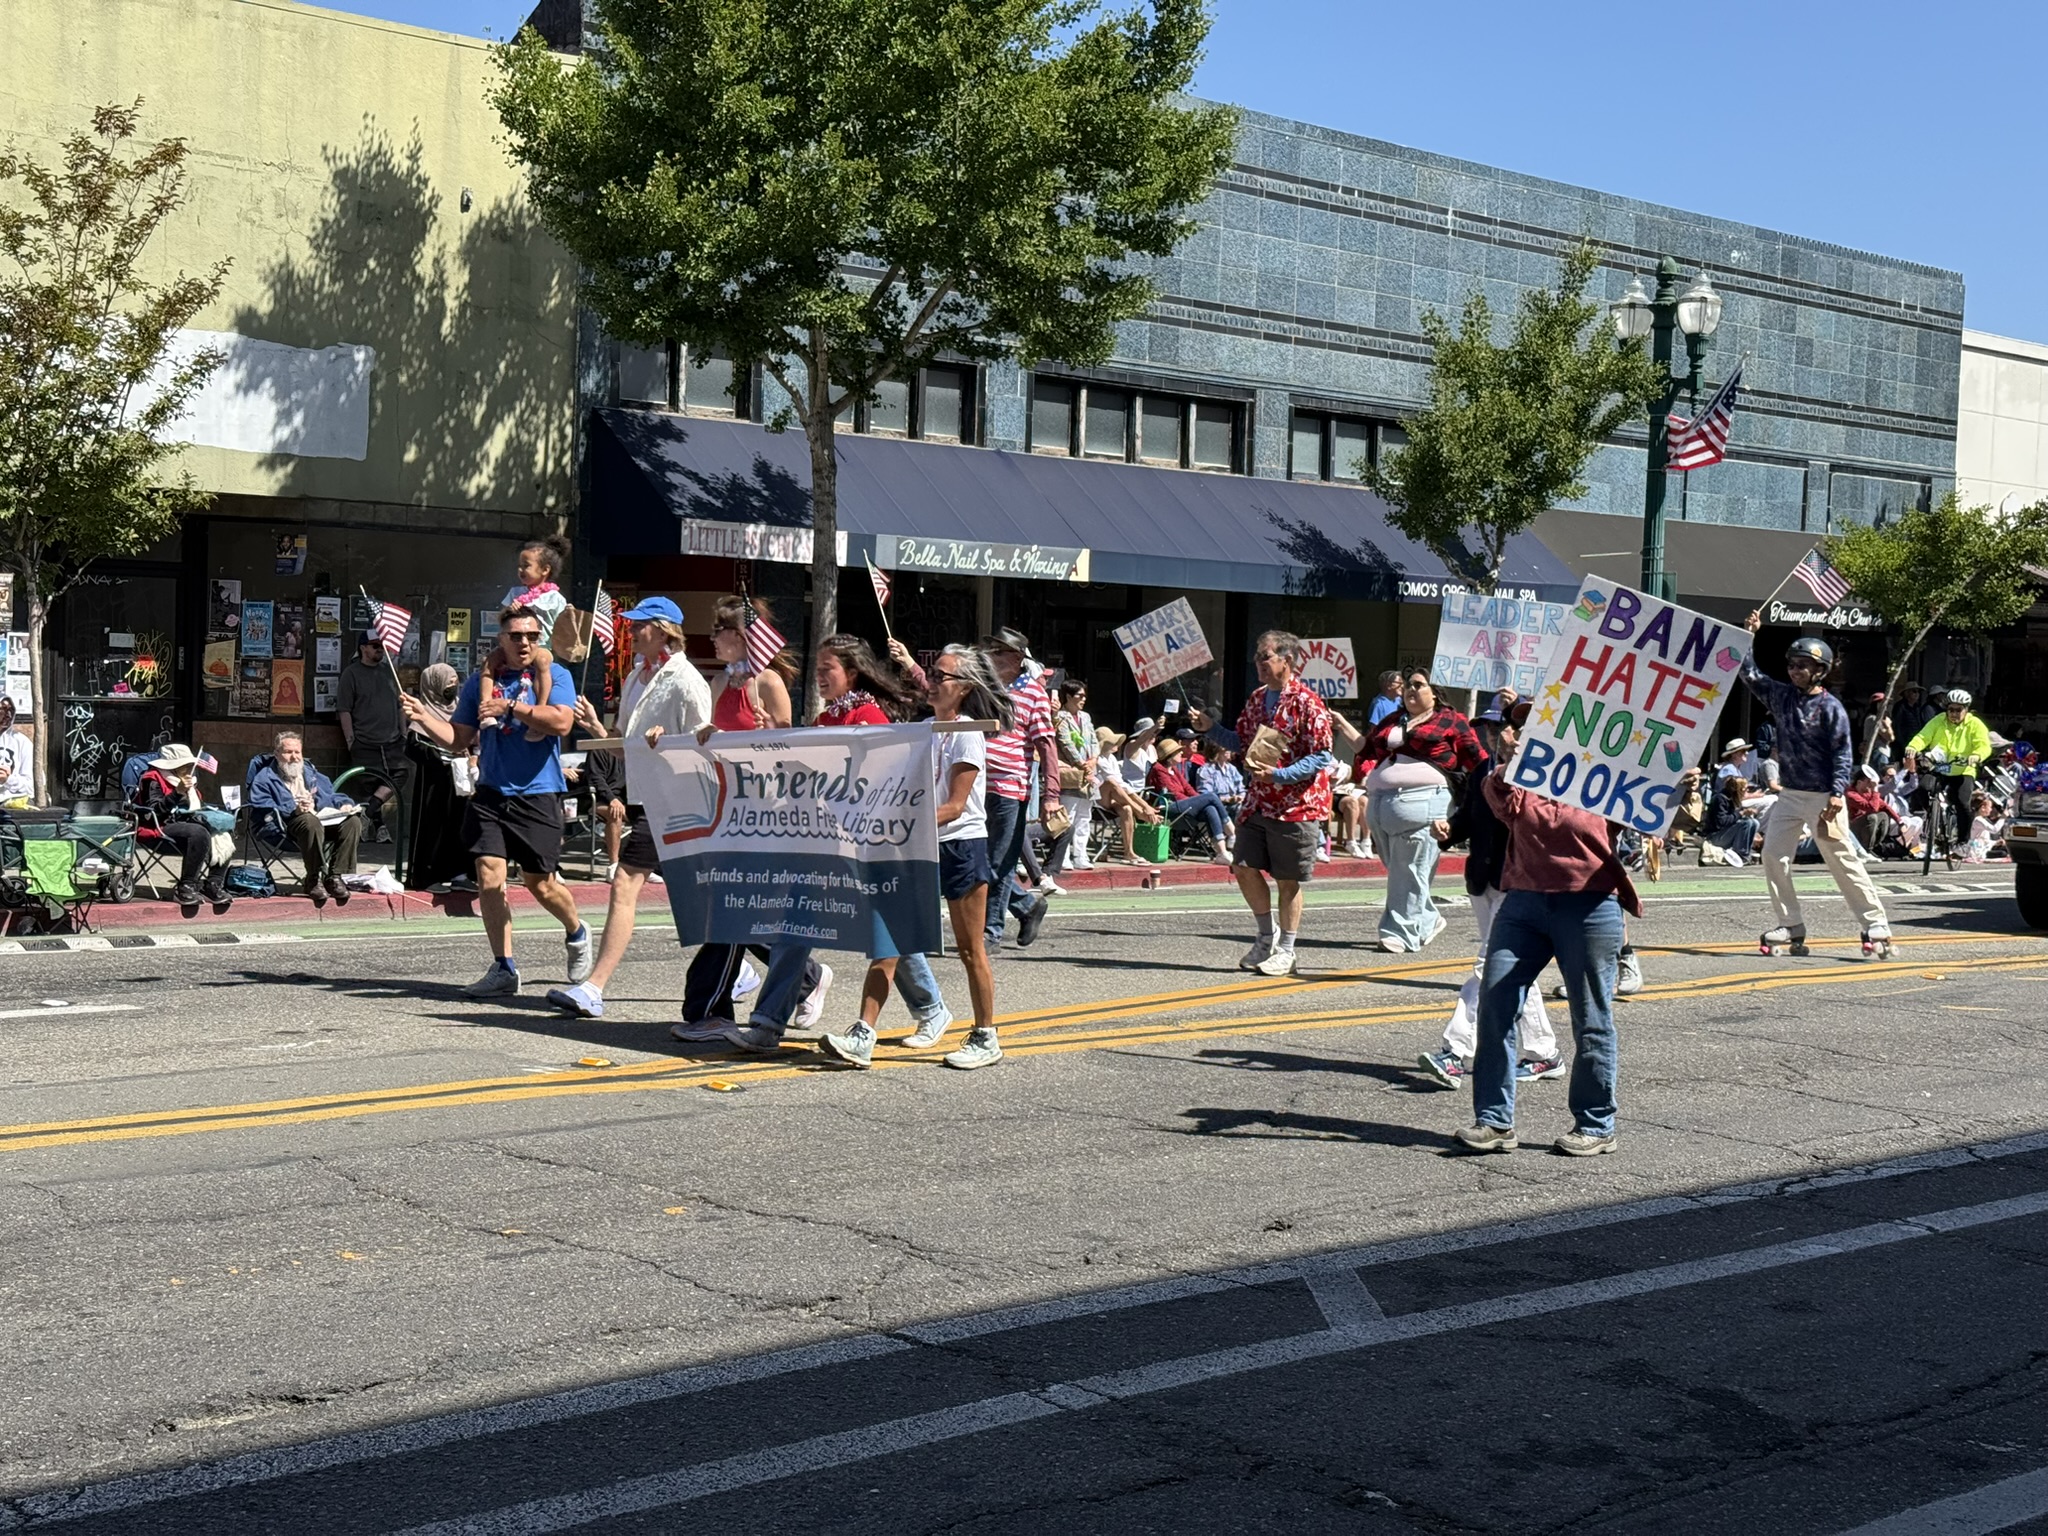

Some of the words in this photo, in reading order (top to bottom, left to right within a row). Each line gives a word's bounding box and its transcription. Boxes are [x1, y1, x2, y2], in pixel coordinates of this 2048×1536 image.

[686, 524, 739, 554] LITTLE
[899, 539, 941, 566] Bella
[942, 542, 978, 570] Nail
[981, 549, 1006, 575] Spa
[1009, 548, 1022, 572] &
[1023, 551, 1069, 579] Waxing
[1398, 581, 1438, 597] TOMO'S
[1519, 589, 1537, 601] SPA
[451, 611, 467, 619] IMP
[1442, 593, 1566, 636] LEADER
[1599, 587, 1722, 673] BAN
[1770, 600, 1828, 626] Triumphant
[1827, 606, 1848, 629] Life
[1131, 642, 1166, 670] ALL
[1165, 621, 1201, 654] ARE
[1467, 629, 1541, 663] ARE
[1560, 635, 1715, 729] HATE
[769, 743, 791, 751] 1974
[1554, 693, 1675, 768] NOT
[730, 757, 869, 805] Friends
[866, 777, 893, 815] of
[882, 776, 926, 807] the
[1512, 738, 1677, 832] BOOKS
[727, 804, 810, 827] Alameda
[842, 811, 916, 840] Library
[709, 868, 743, 883] funds
[746, 870, 769, 884] and
[771, 869, 828, 890] advocating
[828, 872, 841, 887] for
[882, 877, 899, 893] of
[724, 893, 745, 908] the
[747, 894, 794, 909] Alameda
[798, 895, 823, 912] Free
